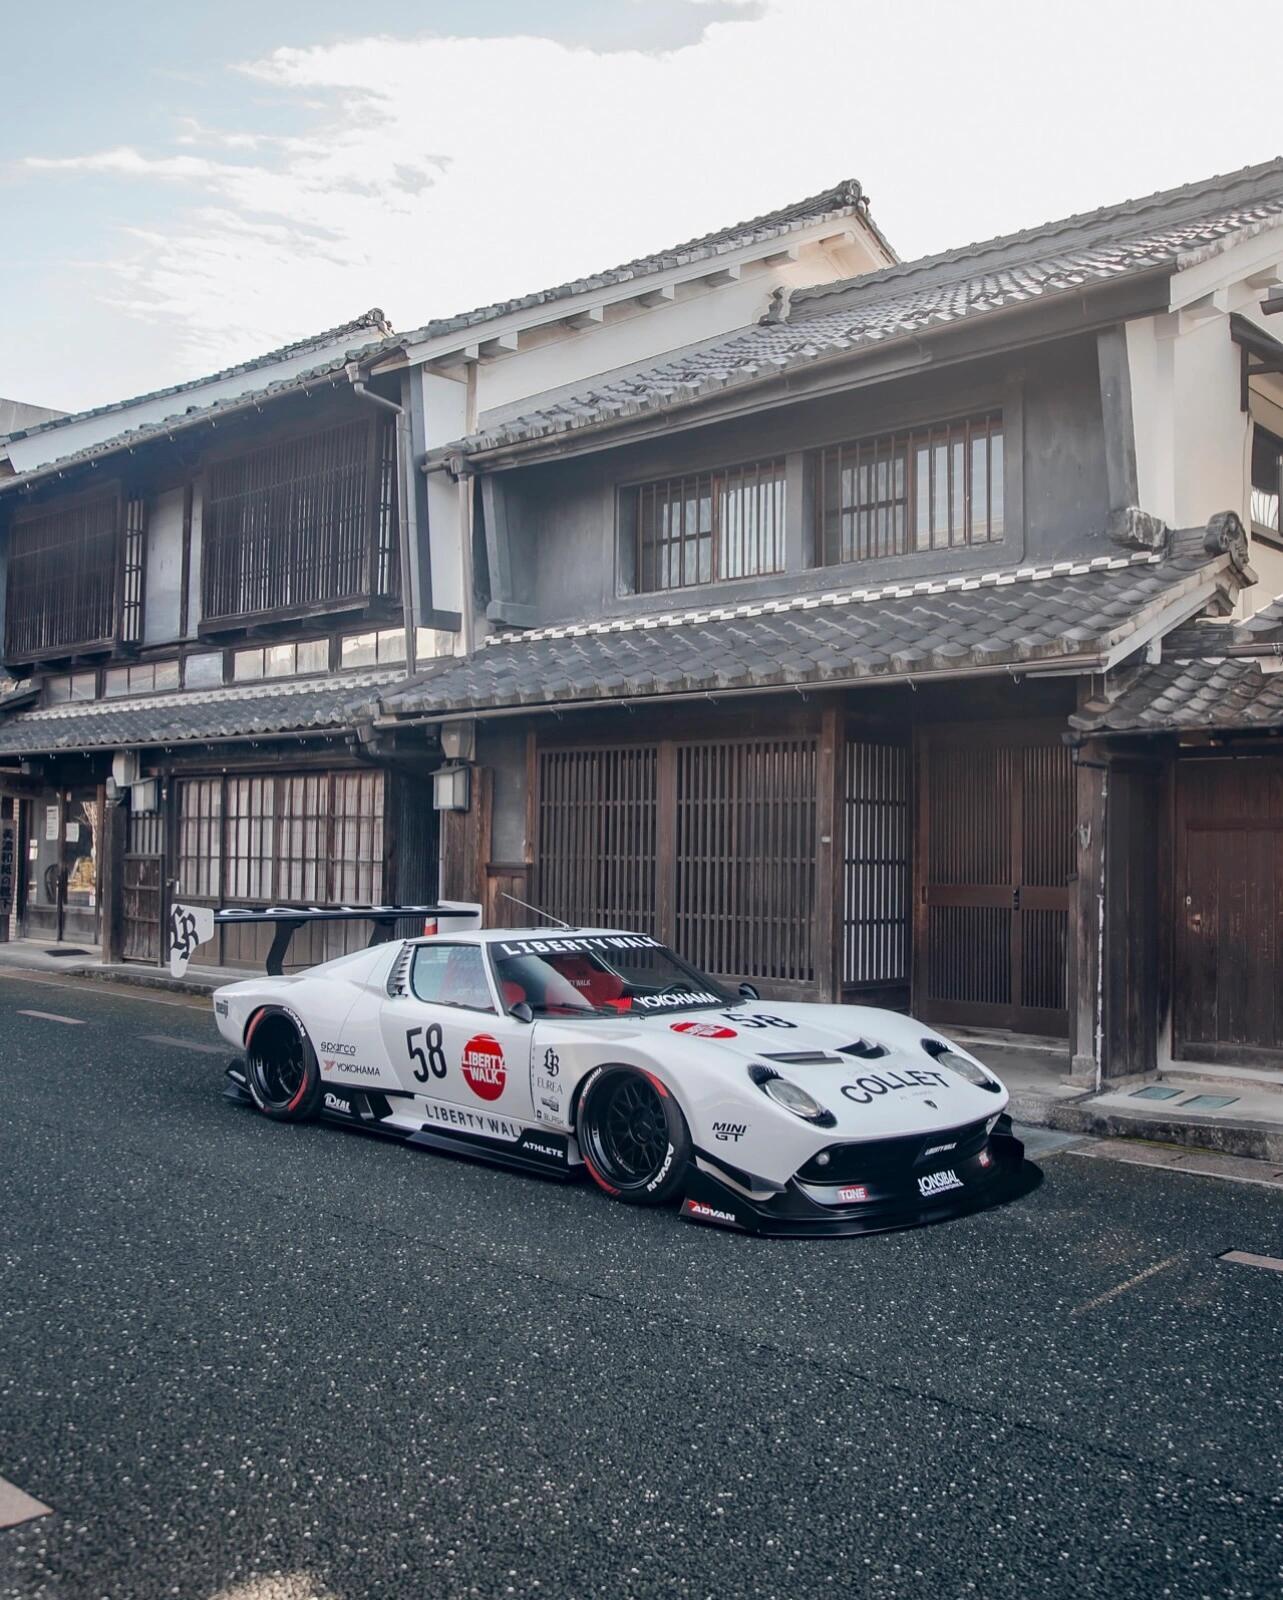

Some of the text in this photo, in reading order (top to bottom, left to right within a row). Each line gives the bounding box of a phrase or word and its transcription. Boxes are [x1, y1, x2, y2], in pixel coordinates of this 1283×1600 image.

[500, 936, 666, 956] LIBERTY WALK
[634, 992, 723, 1009] YOKOHAMA
[721, 1013, 799, 1029] 58
[320, 1040, 356, 1055] sparco
[405, 1022, 448, 1083] 58
[460, 1051, 506, 1071] LIBERTY
[336, 1063, 381, 1077] YOKOHAMA
[840, 1069, 951, 1105] COLLET
[425, 1103, 485, 1130] LIBERTY
[711, 1122, 748, 1134] MINI
[715, 1132, 745, 1143] GT
[522, 1141, 564, 1158] ATHLETE
[646, 1142, 675, 1192] ADVAN
[917, 1169, 960, 1193] JONSIBAL
[838, 1187, 866, 1200] TONE
[691, 1205, 736, 1222] ADVAN
